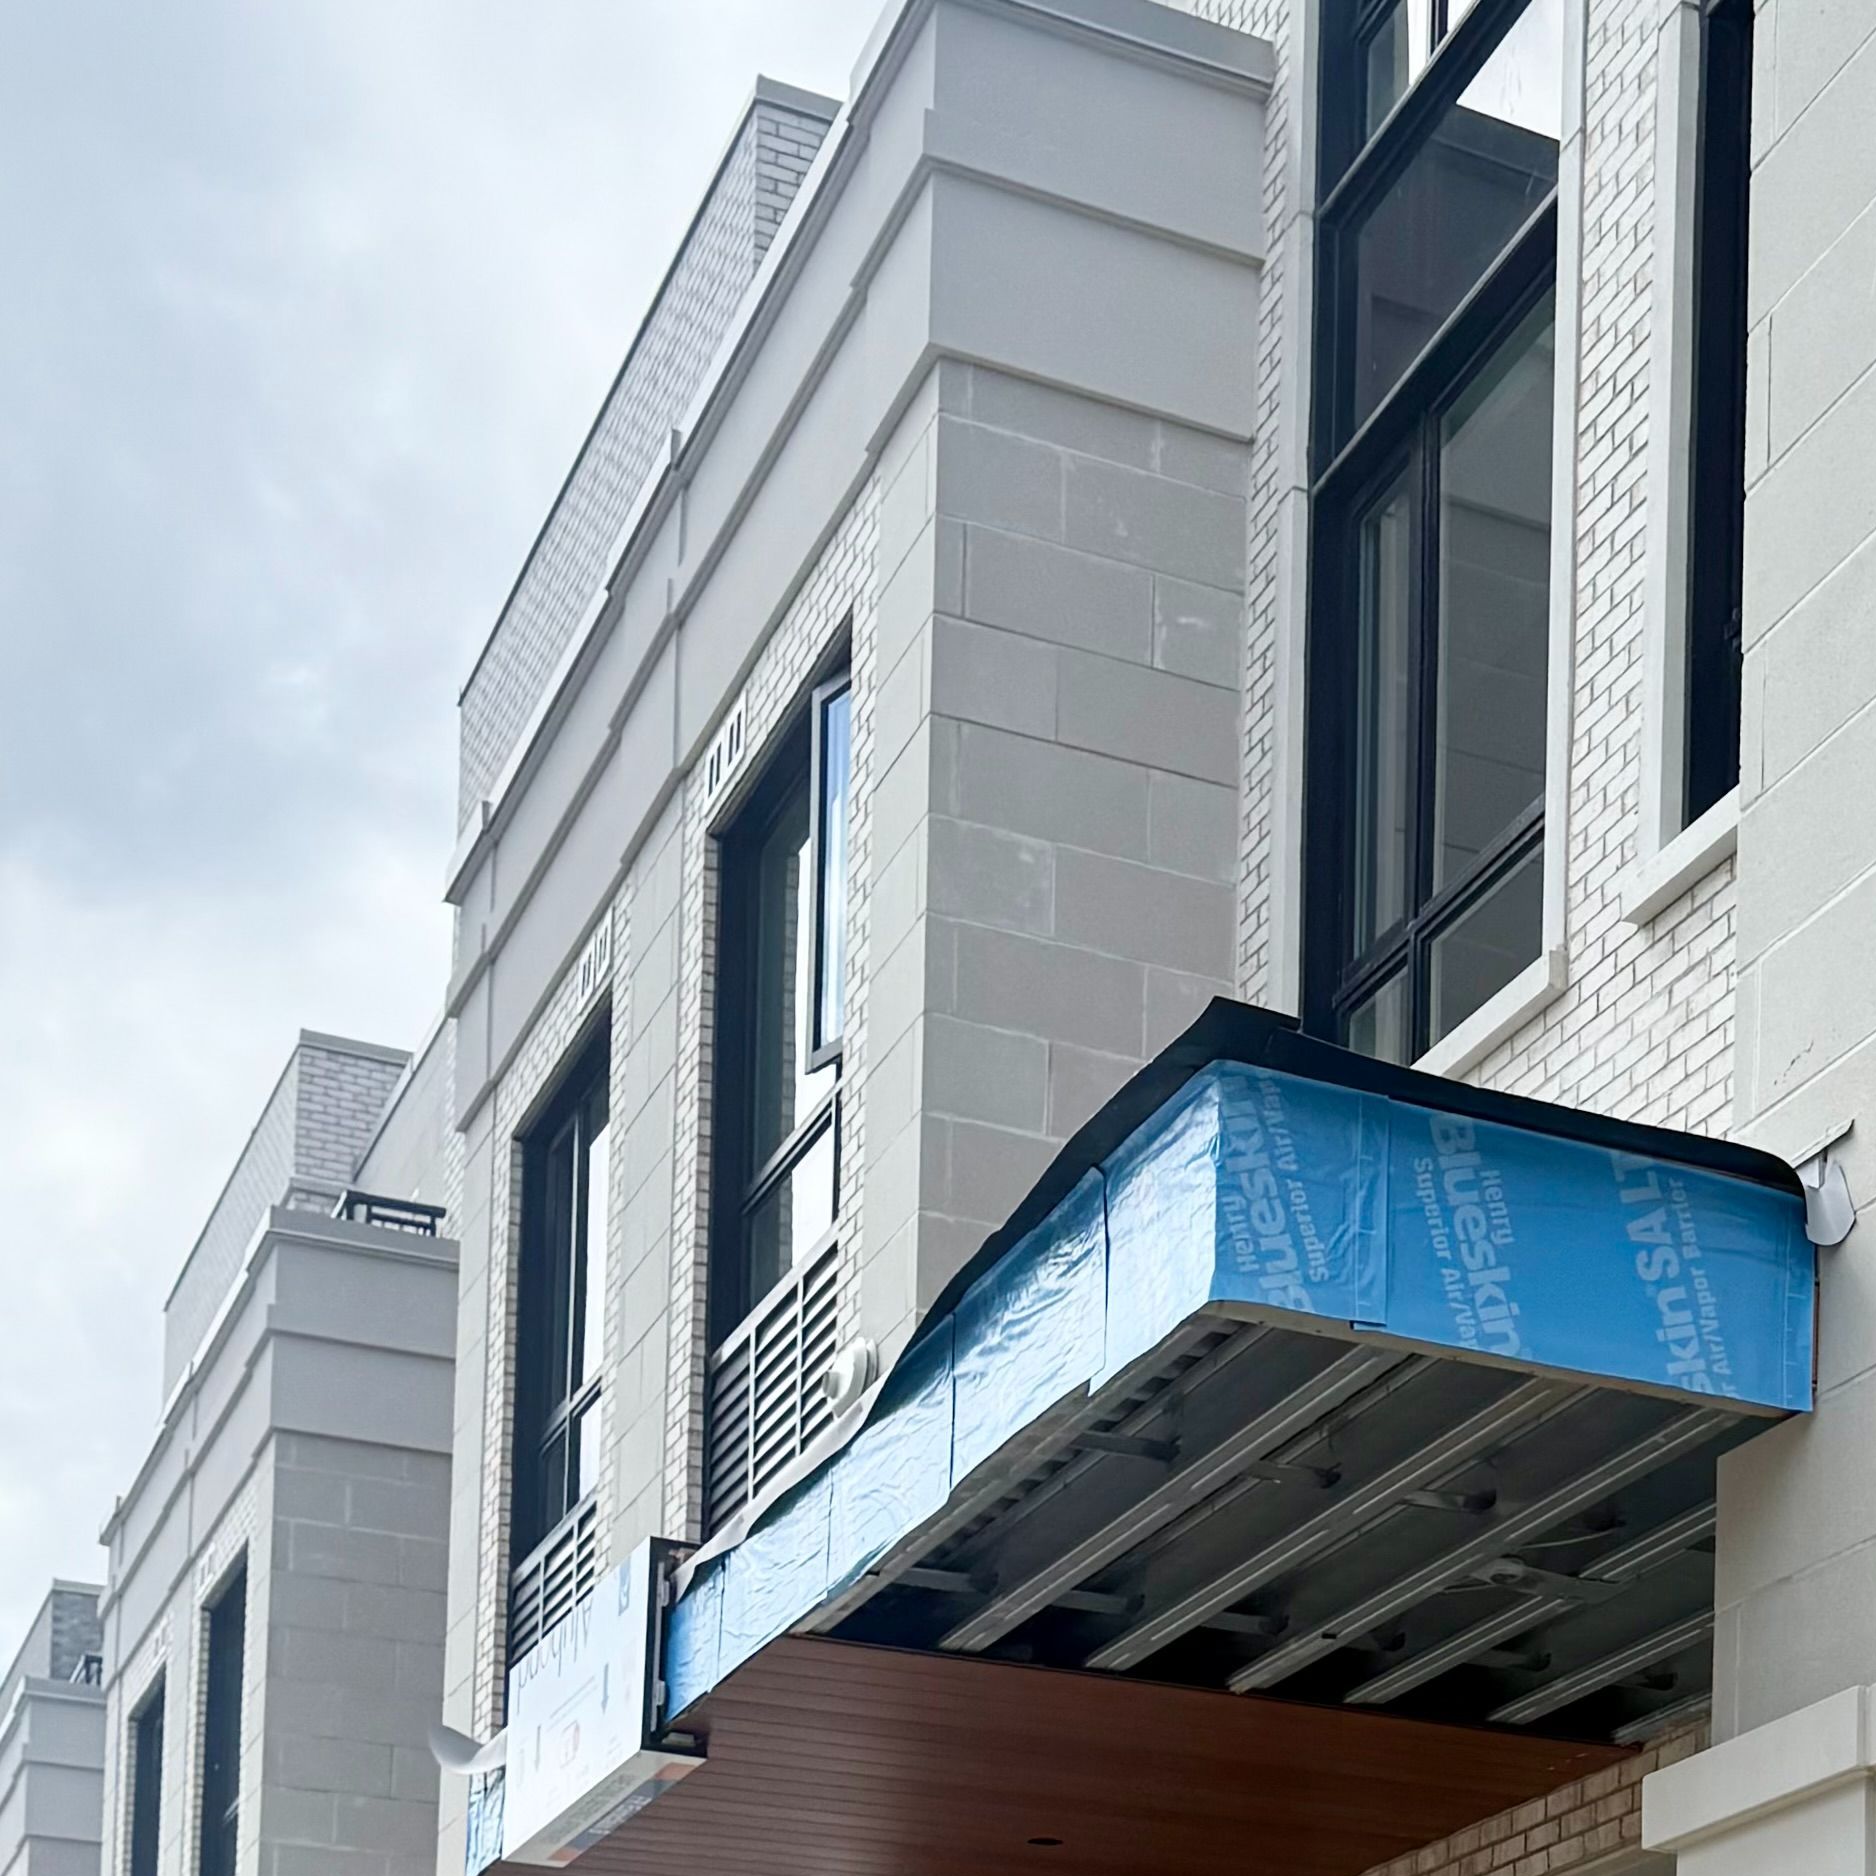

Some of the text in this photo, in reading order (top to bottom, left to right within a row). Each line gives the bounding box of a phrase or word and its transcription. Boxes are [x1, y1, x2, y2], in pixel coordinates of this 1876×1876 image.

[1222, 1193, 1260, 1273] Henry
[1286, 1177, 1329, 1283] Superior
[1413, 1156, 1452, 1261] Superior
[1479, 1168, 1516, 1247] Henry
